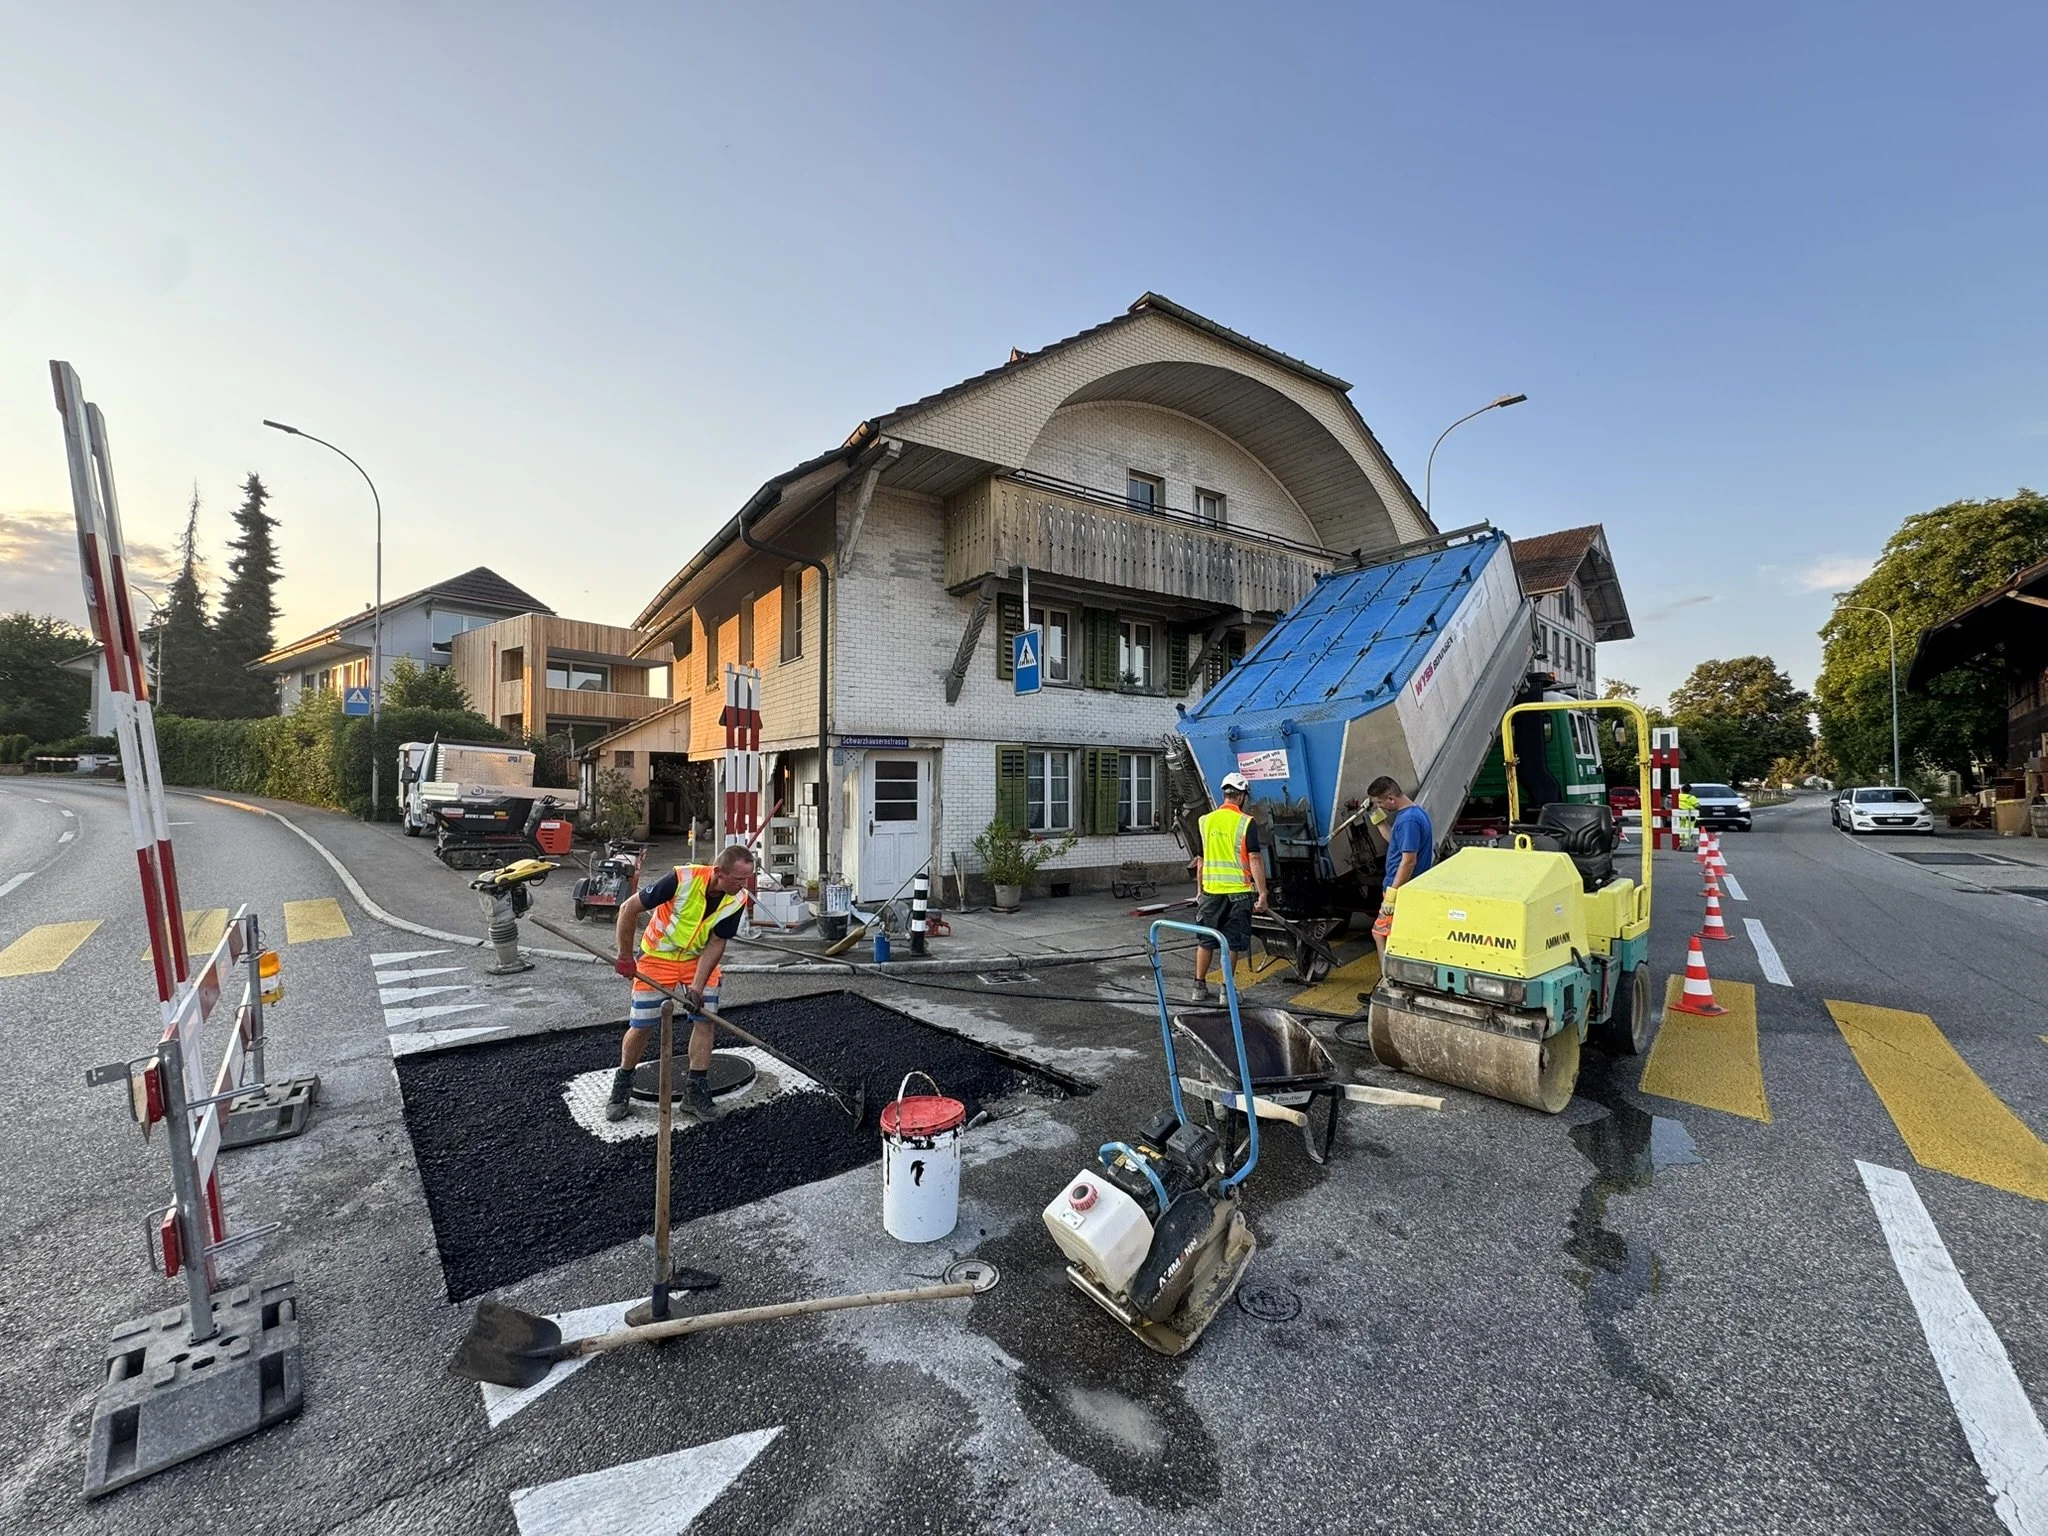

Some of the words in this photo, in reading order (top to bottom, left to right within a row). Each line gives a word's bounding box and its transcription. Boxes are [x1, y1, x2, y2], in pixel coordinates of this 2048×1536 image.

[1414, 662, 1434, 696] WYSS
[1447, 930, 1517, 950] AMMANN
[1545, 931, 1571, 950] AMMANN
